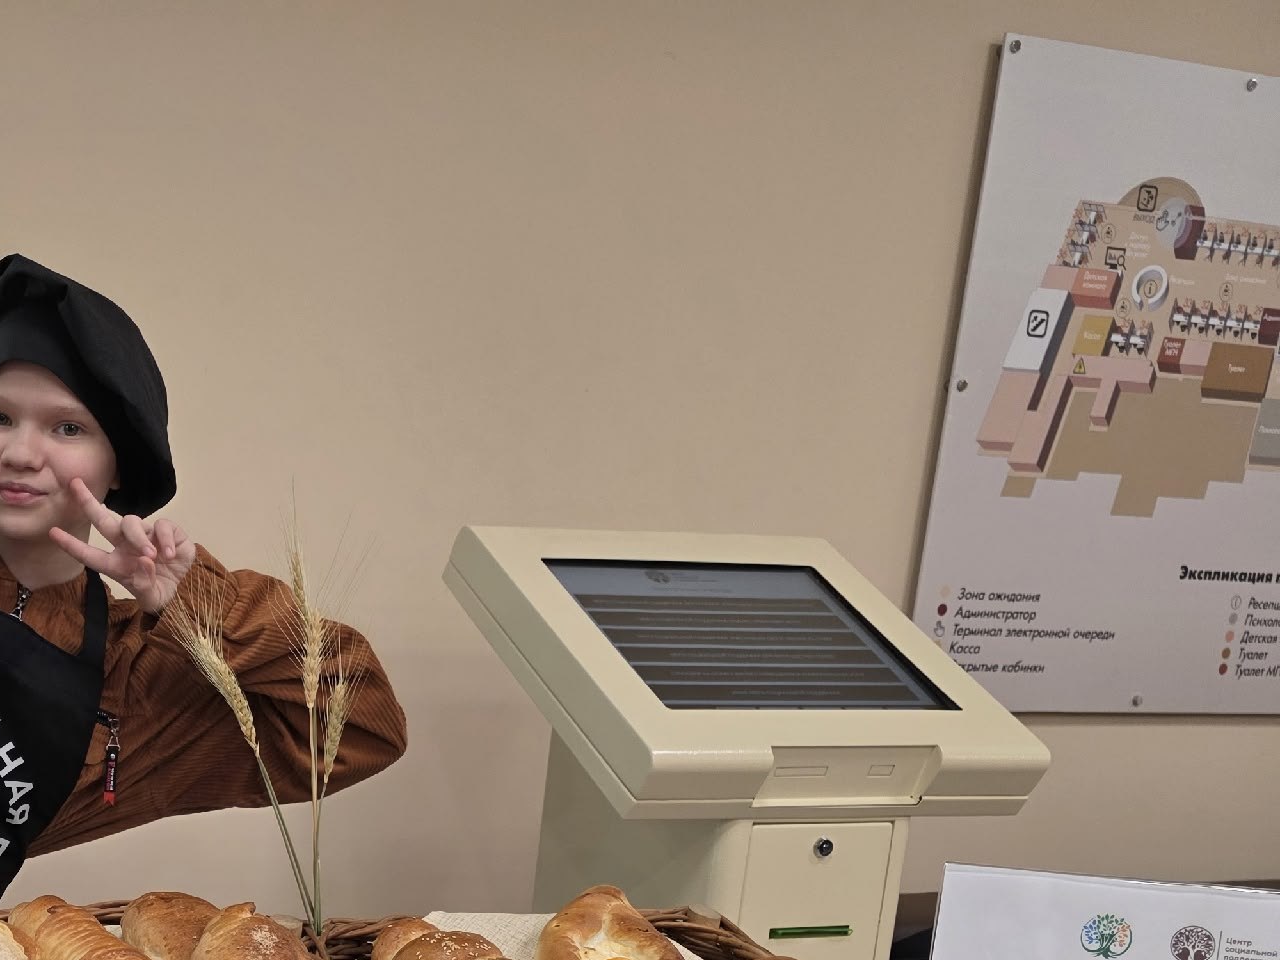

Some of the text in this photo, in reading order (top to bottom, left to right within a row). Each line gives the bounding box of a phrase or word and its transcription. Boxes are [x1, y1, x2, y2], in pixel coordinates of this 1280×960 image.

[1180, 565, 1273, 584] Экспликация
[957, 587, 1041, 603] Зона ожидания
[954, 606, 1037, 623] Администратор
[952, 623, 1116, 644] Терминал электронной очереди
[1239, 630, 1278, 644] Детская
[948, 640, 981, 655] Касса
[1238, 647, 1268, 662] Туалет
[953, 659, 1045, 673] крытые кабинки
[1235, 664, 1265, 680] Туалет
[1225, 937, 1252, 947] Центр
[1224, 947, 1278, 957] социальной
